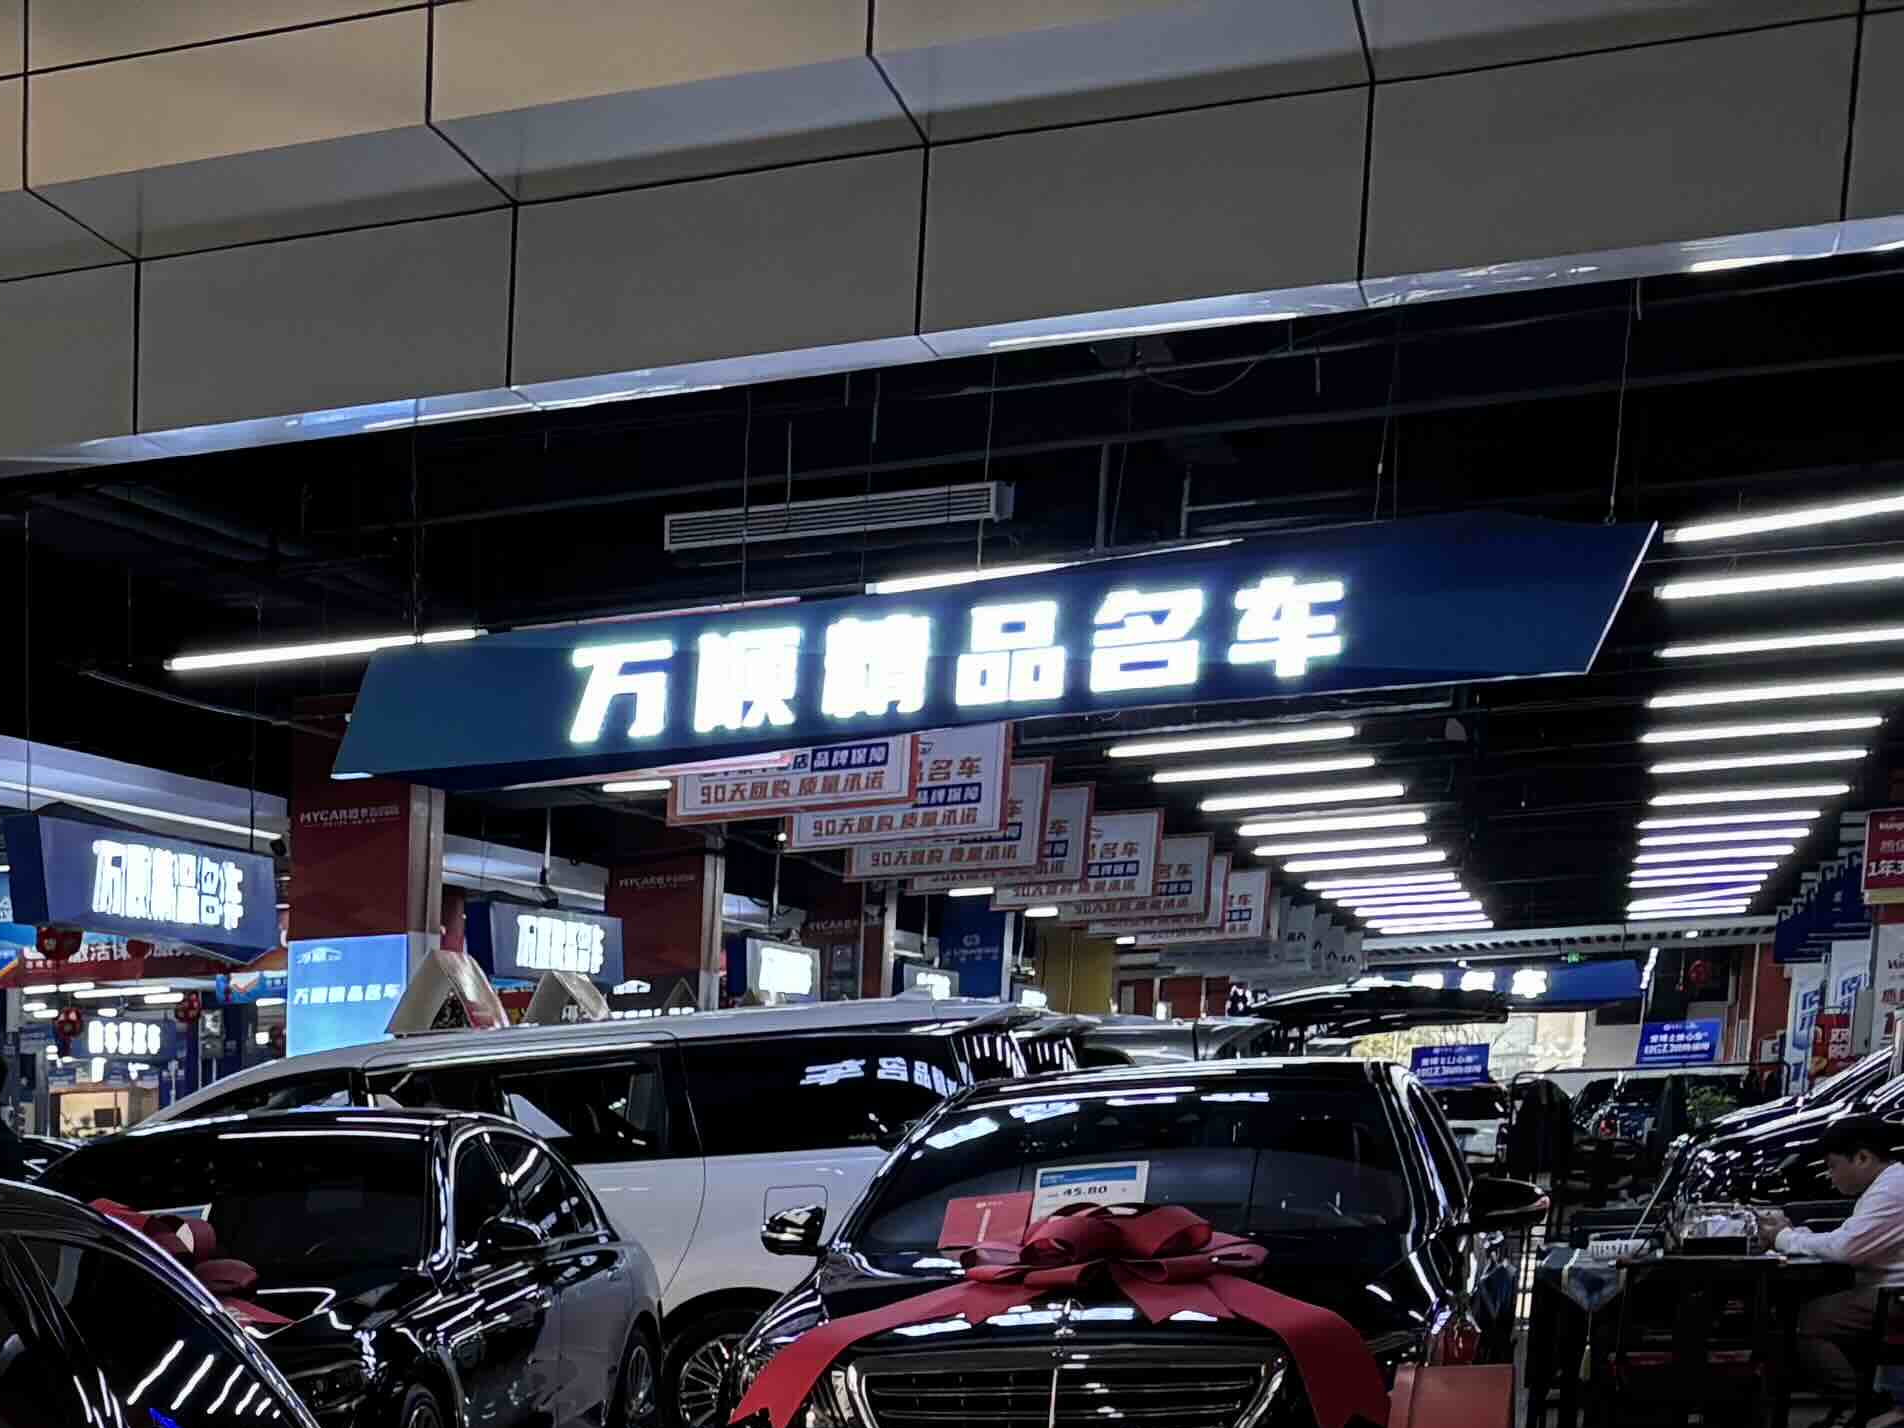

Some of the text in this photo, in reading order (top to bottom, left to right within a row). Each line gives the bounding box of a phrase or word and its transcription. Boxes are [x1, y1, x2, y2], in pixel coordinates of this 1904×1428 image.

[570, 576, 1345, 743] 万顺精品名车
[919, 756, 982, 783] 名车
